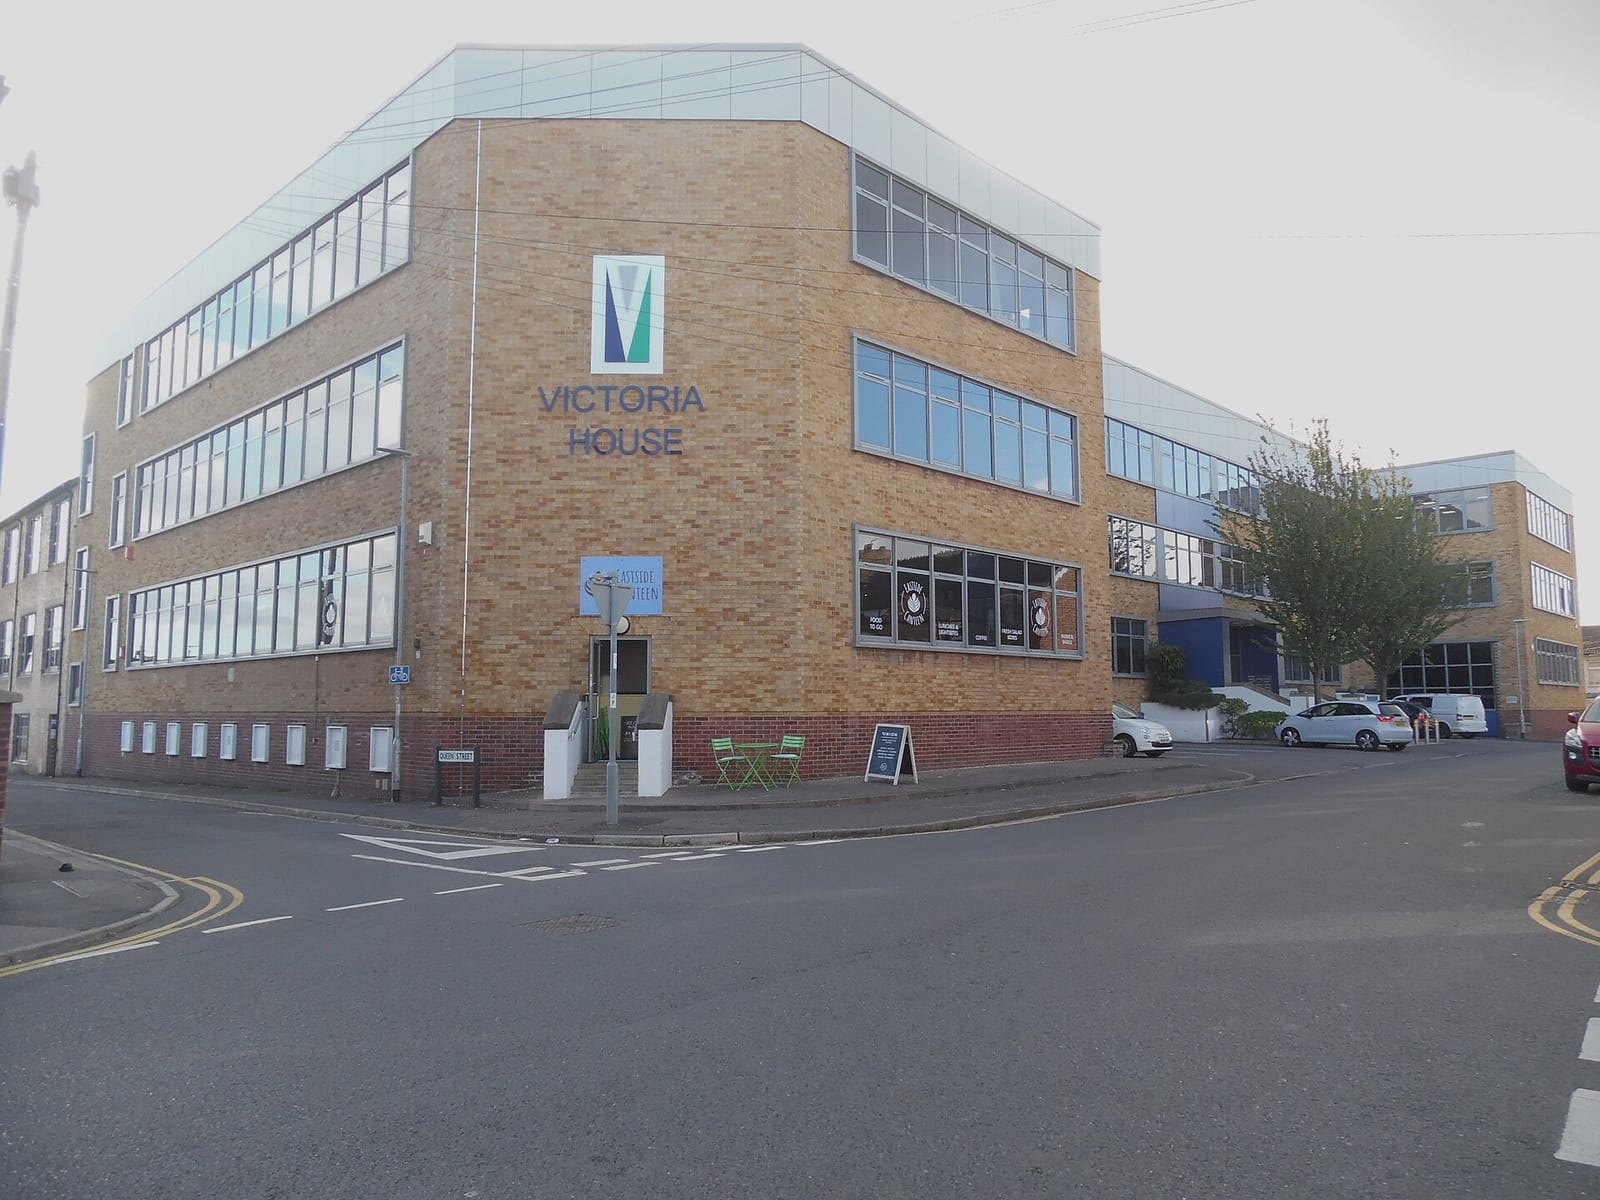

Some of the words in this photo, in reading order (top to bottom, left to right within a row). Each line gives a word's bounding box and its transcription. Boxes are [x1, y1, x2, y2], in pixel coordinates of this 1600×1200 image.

[538, 385, 705, 413] VICTORIA
[569, 427, 683, 455] HOUSE
[617, 570, 654, 583] ASTSIDE
[632, 587, 659, 600] TEEN
[440, 752, 454, 760] QUEEN
[456, 752, 473, 760] STREET
